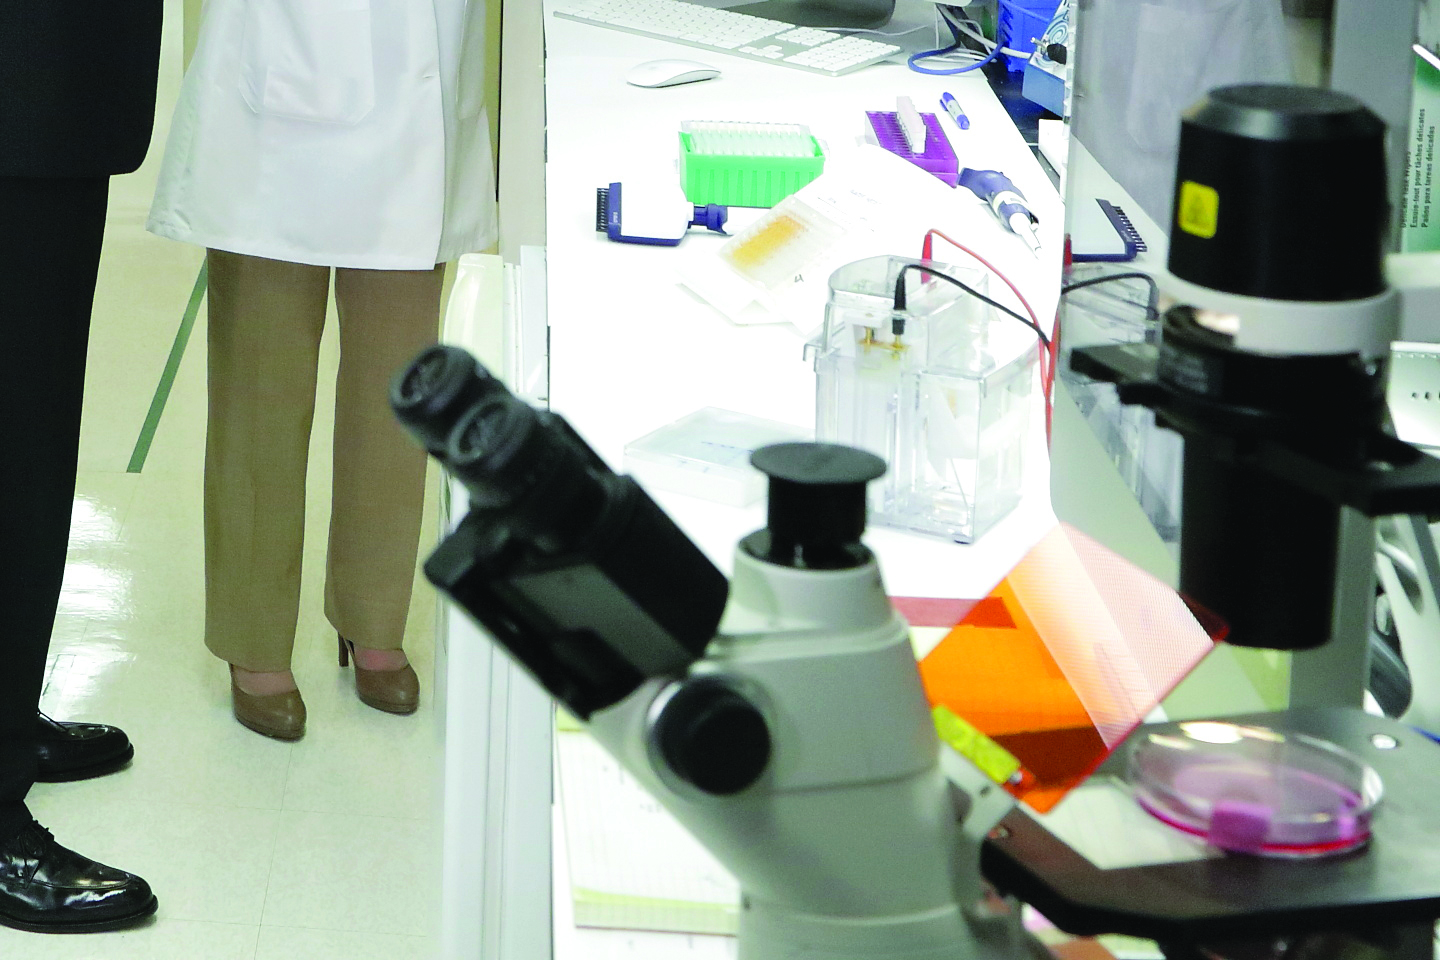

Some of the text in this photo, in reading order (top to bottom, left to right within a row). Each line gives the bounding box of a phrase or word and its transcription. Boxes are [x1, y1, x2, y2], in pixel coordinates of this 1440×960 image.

[1426, 126, 1435, 162] delicadas
[1414, 170, 1422, 186] pour
[1424, 187, 1432, 204] para
